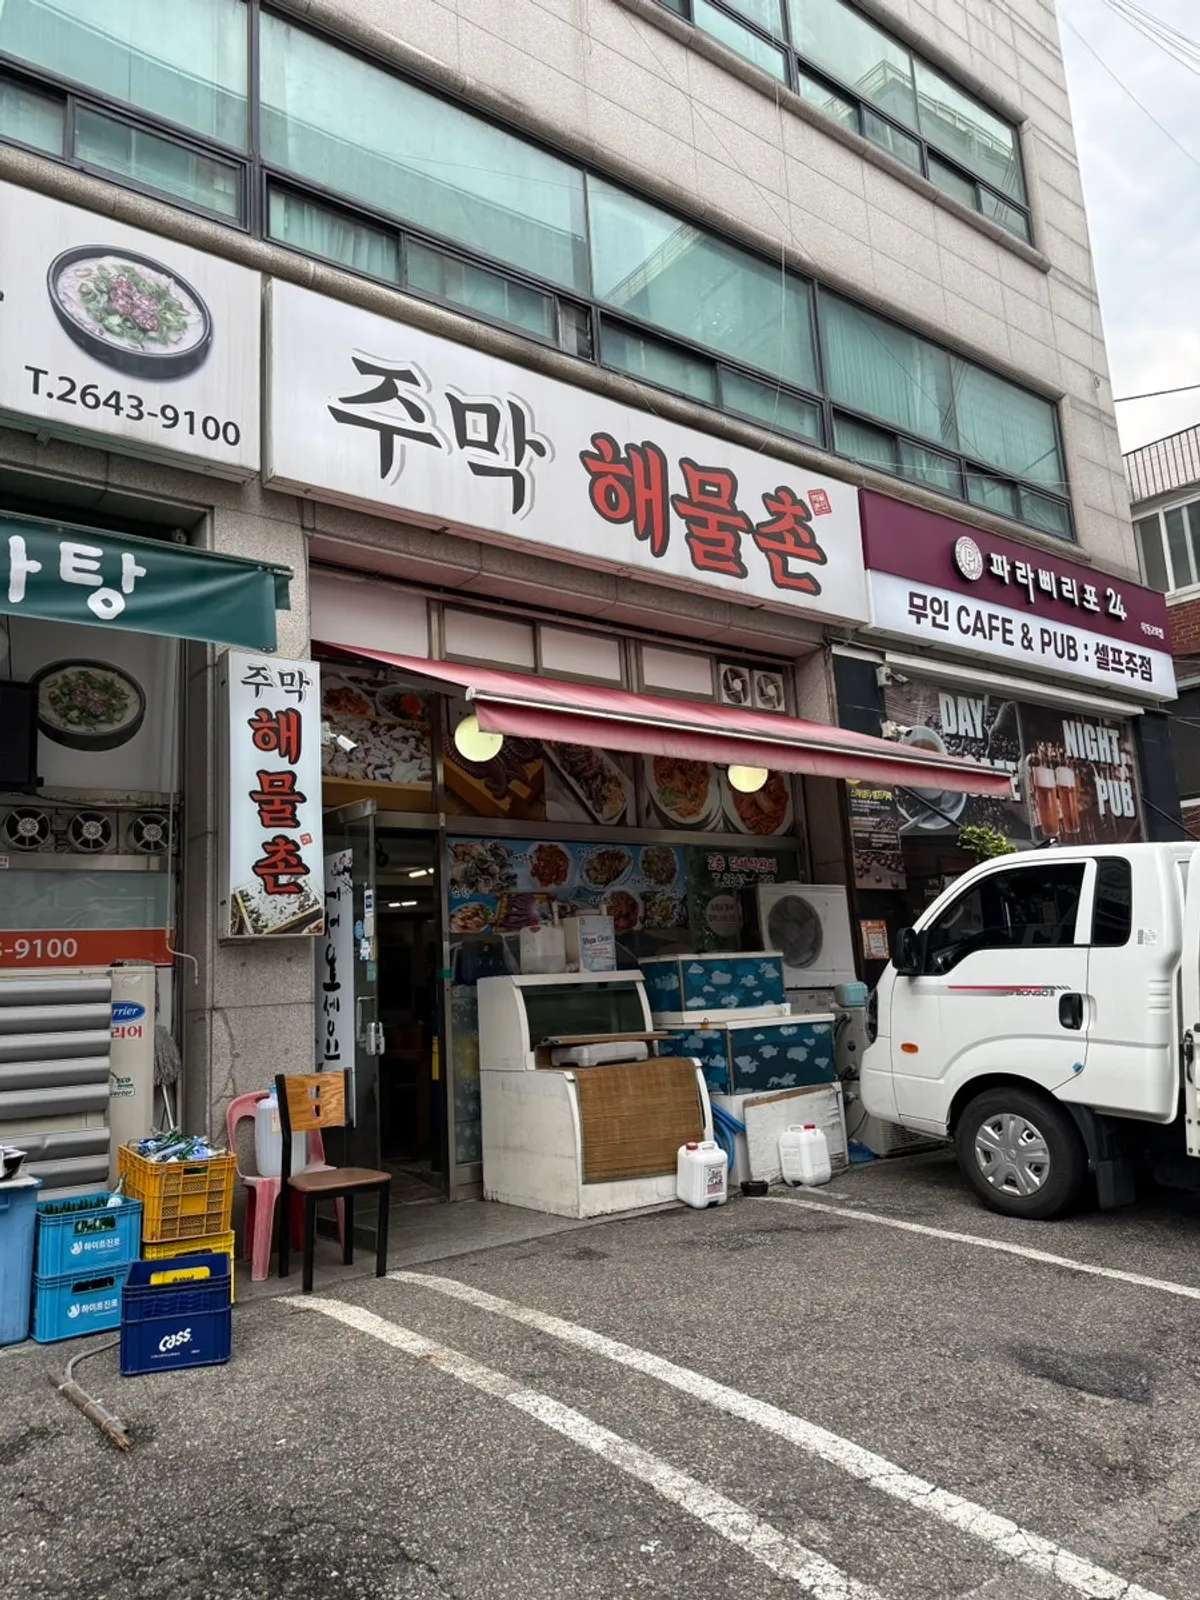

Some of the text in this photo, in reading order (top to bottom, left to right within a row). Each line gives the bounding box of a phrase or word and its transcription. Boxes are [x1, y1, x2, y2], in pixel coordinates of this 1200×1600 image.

[25, 365, 241, 446] T.2643-9100
[327, 355, 828, 596] 주막 해물촌
[988, 552, 1128, 622] 파라삐리포 24
[908, 591, 950, 631] 무인
[956, 605, 1015, 647] CAFE
[1020, 622, 1034, 651] &
[1040, 627, 1079, 662] PUB
[1094, 641, 1154, 682] 셀프주점
[241, 665, 311, 703] 주막
[938, 692, 987, 739] DAY
[1062, 719, 1121, 764] NIGHT
[248, 706, 310, 895] 해물촌
[1095, 774, 1136, 818] PUB
[111, 1025, 143, 1039] 리어
[112, 1006, 139, 1016] rrier
[158, 1327, 192, 1351] Cass
